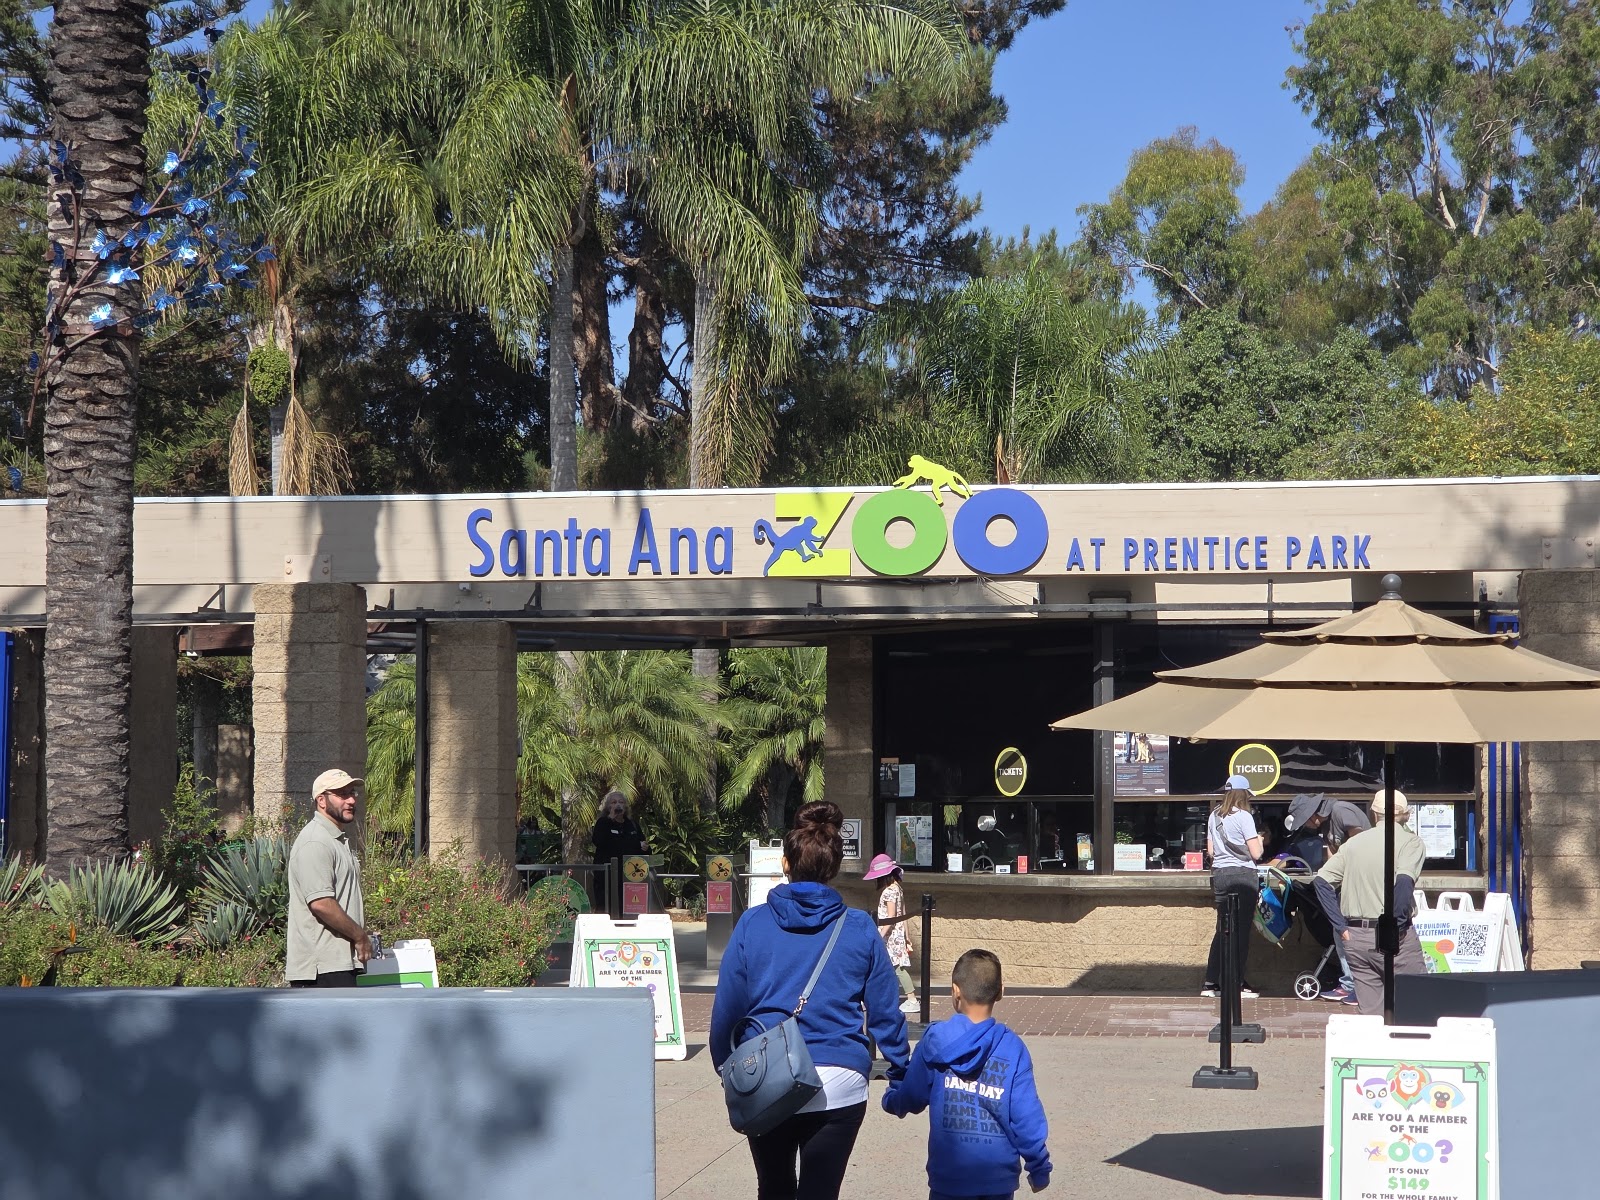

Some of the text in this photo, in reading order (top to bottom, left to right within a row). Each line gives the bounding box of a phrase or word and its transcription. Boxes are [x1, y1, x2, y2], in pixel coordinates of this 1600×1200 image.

[467, 488, 1372, 577] Santa Ana ZOO AT PRENTICE PARK
[998, 767, 1023, 776] TICKETS
[1235, 764, 1275, 773] TICKETS
[979, 1083, 1004, 1099] DAY
[1352, 1112, 1468, 1124] ARE YOU A MEMBER
[1389, 1125, 1429, 1134] OF THE
[1367, 1139, 1454, 1164] ZOO?
[1387, 1176, 1430, 1190] $149
